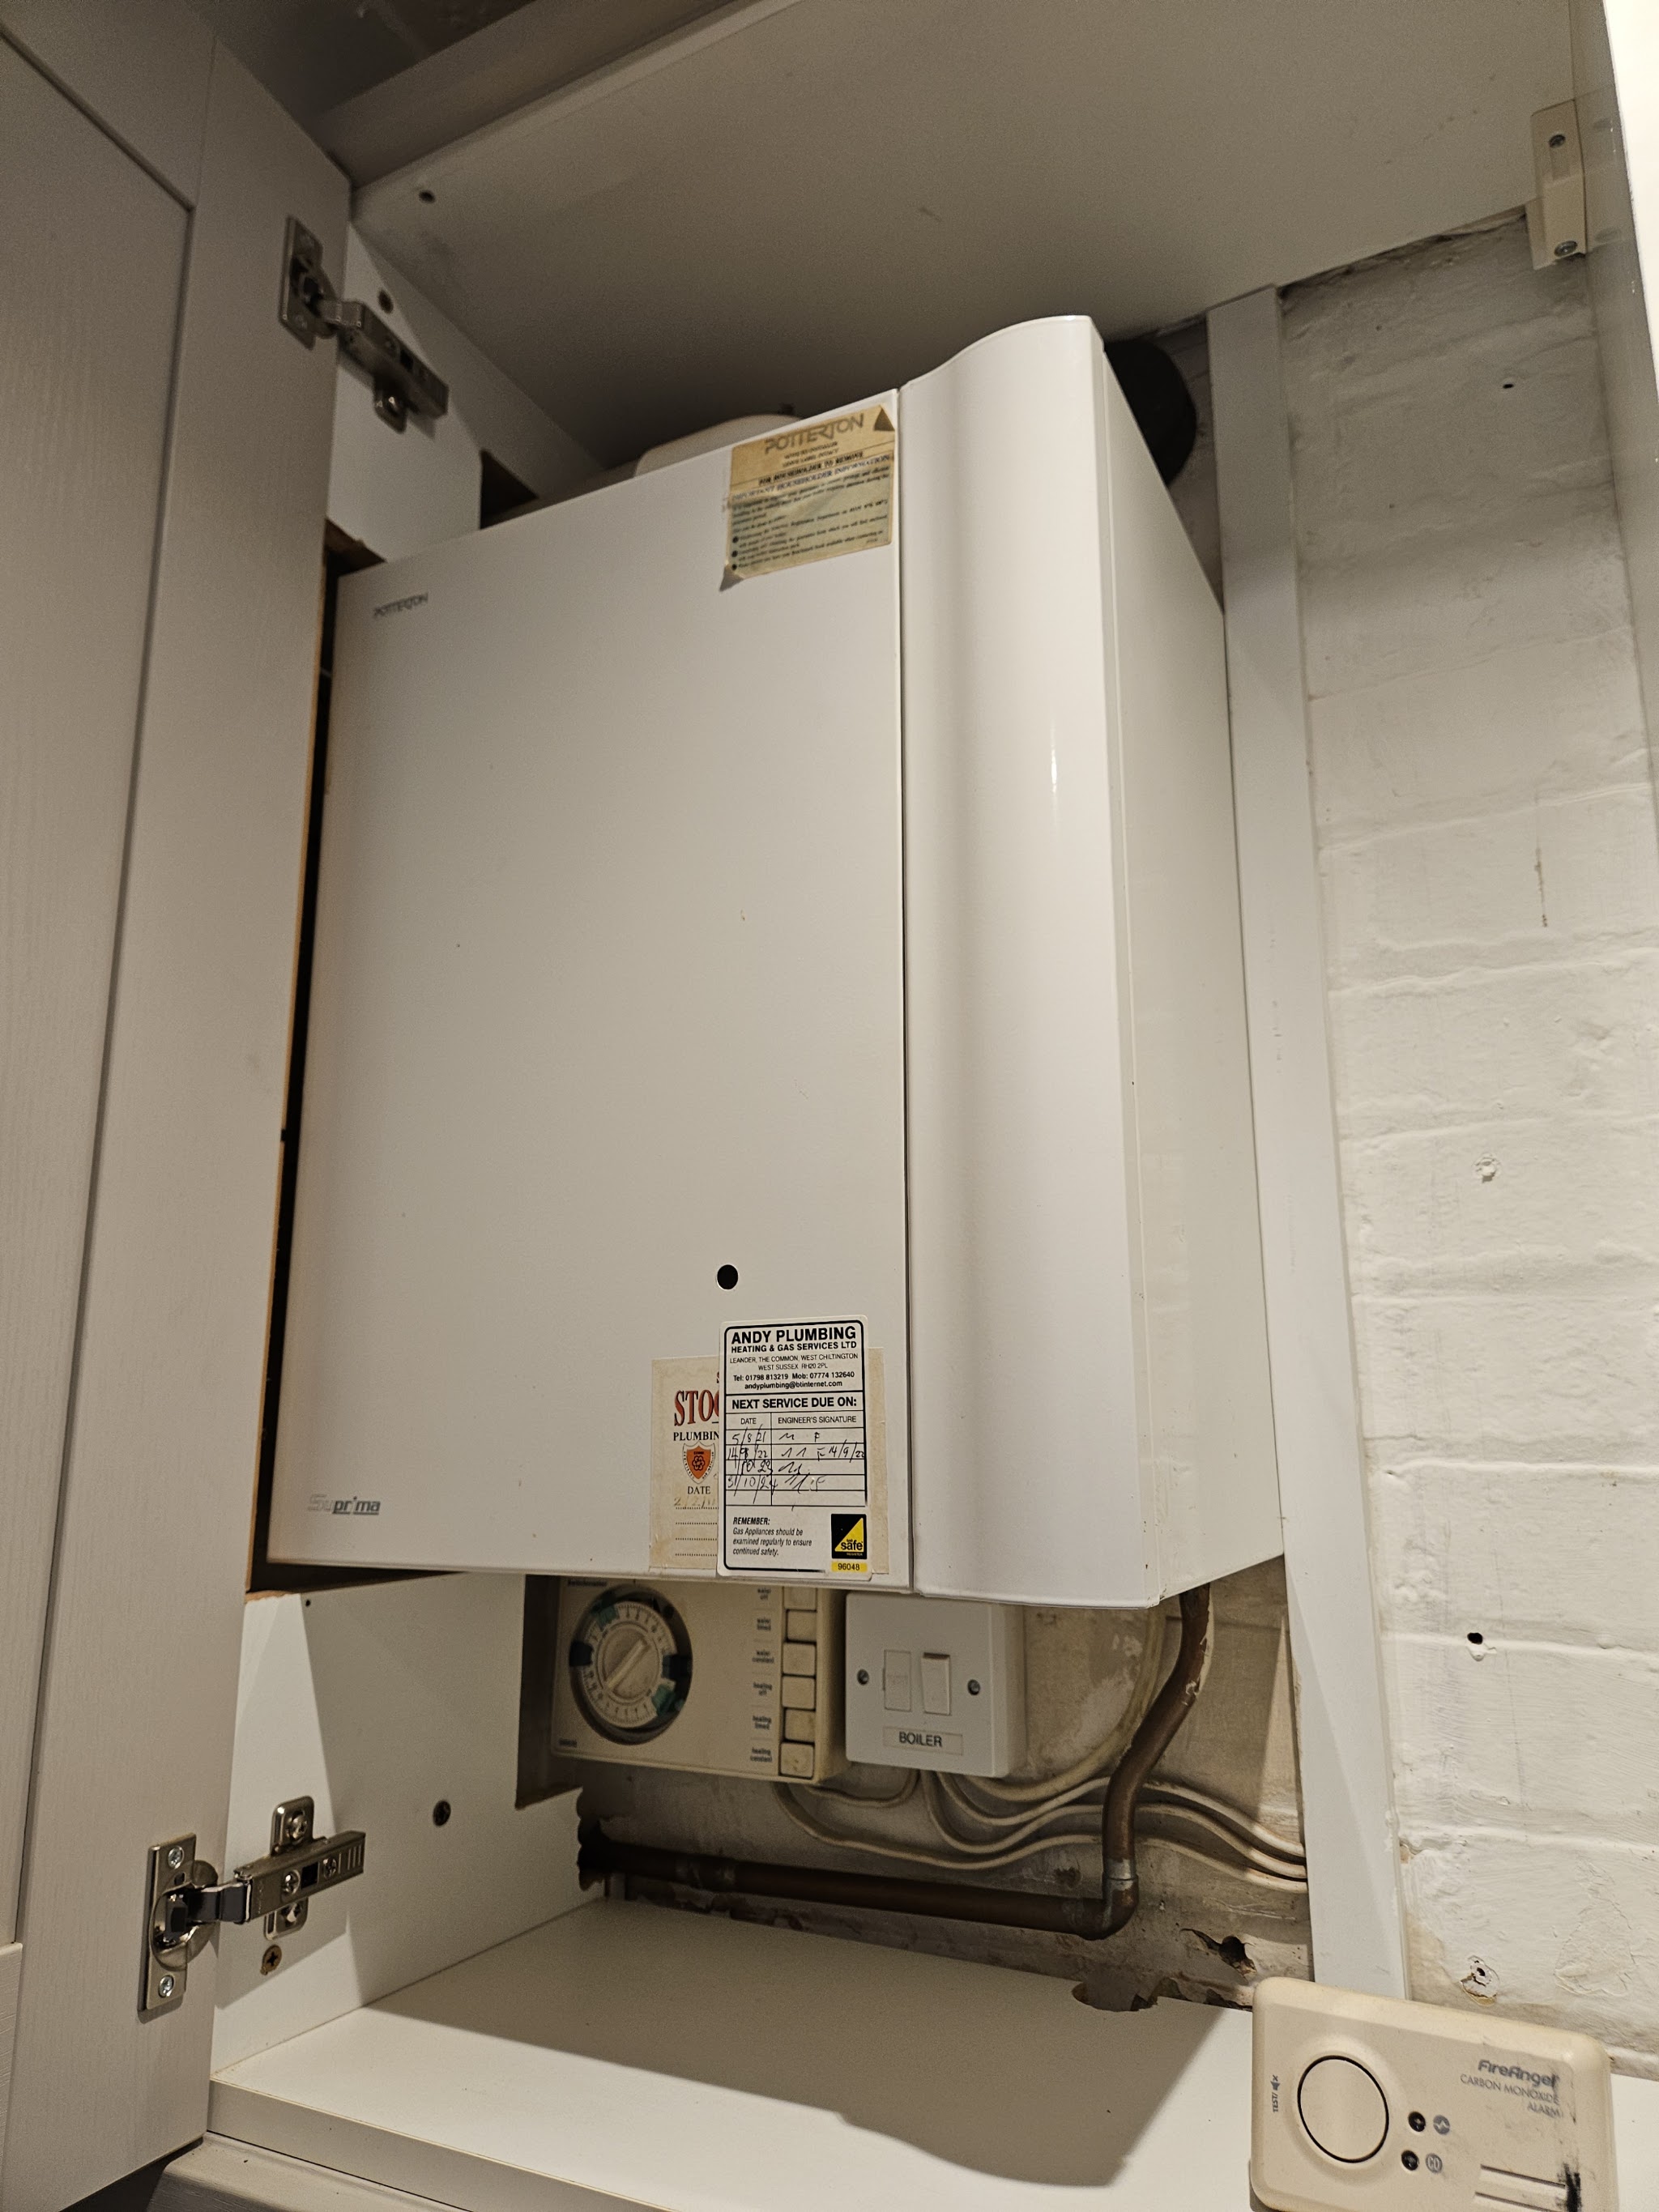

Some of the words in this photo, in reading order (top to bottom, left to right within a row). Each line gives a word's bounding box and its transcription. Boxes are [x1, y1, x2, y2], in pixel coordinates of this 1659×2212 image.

[764, 413, 864, 454] POTTERTON
[731, 1330, 771, 1345] ANDY
[776, 1326, 856, 1342] PLUMBING
[731, 1345, 766, 1353] HEATING
[797, 1342, 838, 1350] SERVICES
[744, 1381, 842, 1390] andyplumbing@btinternet.com
[731, 1399, 760, 1409] NEXT
[762, 1398, 808, 1409] SERVICE
[812, 1397, 834, 1408] DUE
[838, 1396, 857, 1406] ON:
[687, 1485, 711, 1495] DATE
[733, 1517, 770, 1525] REMEMBER:
[744, 1528, 774, 1536] Appliances
[775, 1528, 795, 1536] should
[733, 1537, 760, 1545] examined
[760, 1537, 785, 1547] regularly
[841, 1540, 863, 1550] safe
[733, 1547, 760, 1555] continued
[761, 1548, 779, 1557] safety.
[838, 1562, 859, 1571] 96048
[898, 1731, 942, 1747] BOILER
[1478, 2059, 1558, 2088] FireAngel
[1460, 2073, 1501, 2091] CARBON
[1503, 2085, 1560, 2106] MONOXIDE
[1527, 2102, 1561, 2119] ALARM
